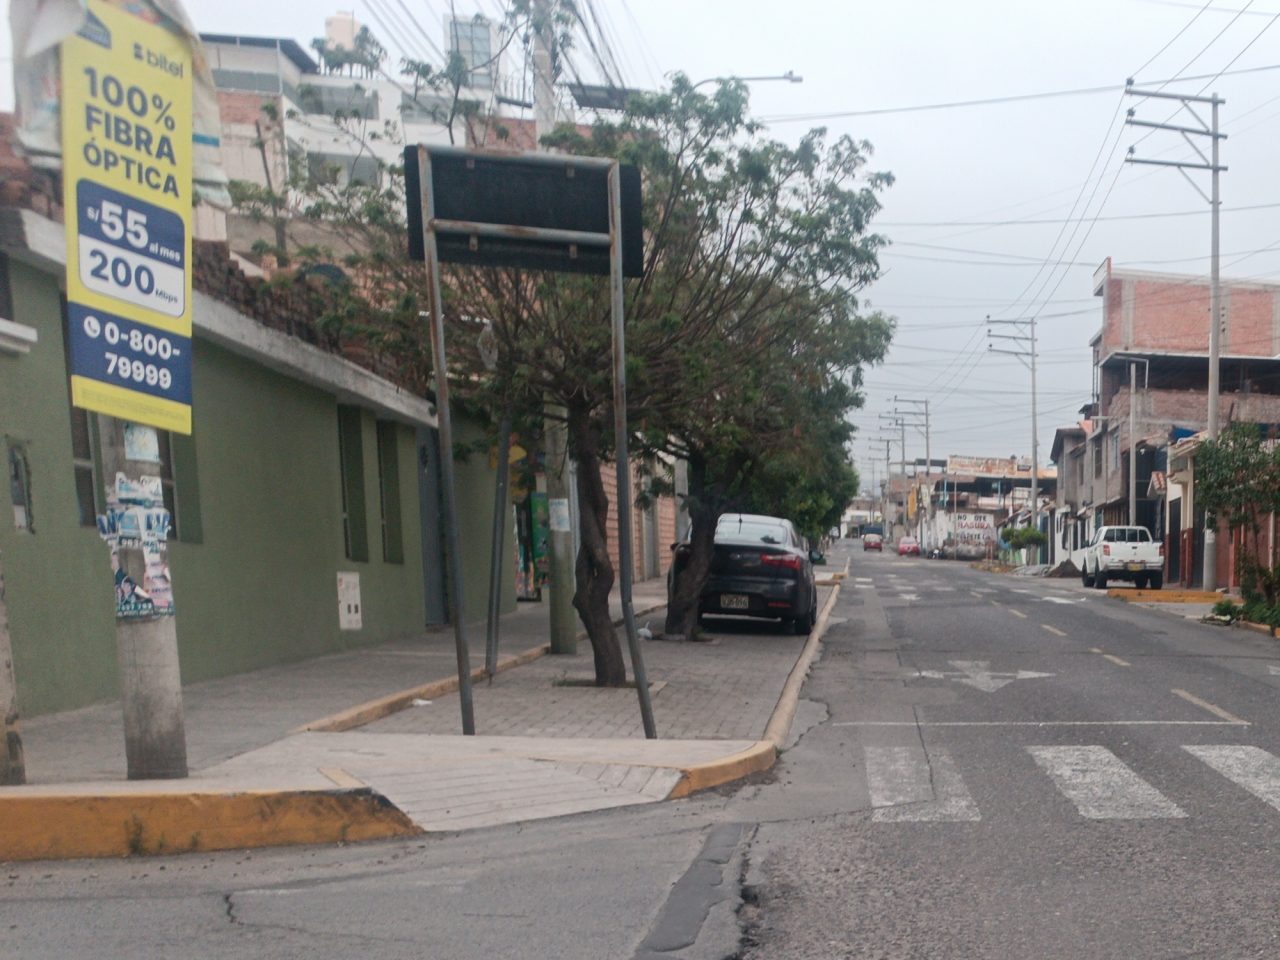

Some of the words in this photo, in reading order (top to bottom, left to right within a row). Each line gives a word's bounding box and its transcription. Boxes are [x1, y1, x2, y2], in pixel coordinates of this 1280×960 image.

[146, 48, 184, 78] bitel
[84, 66, 175, 131] 100%
[85, 103, 177, 166] FIBRA
[89, 248, 155, 296] 200
[160, 246, 181, 263] mes
[104, 321, 181, 360] 0-800-
[104, 351, 172, 390] 79999
